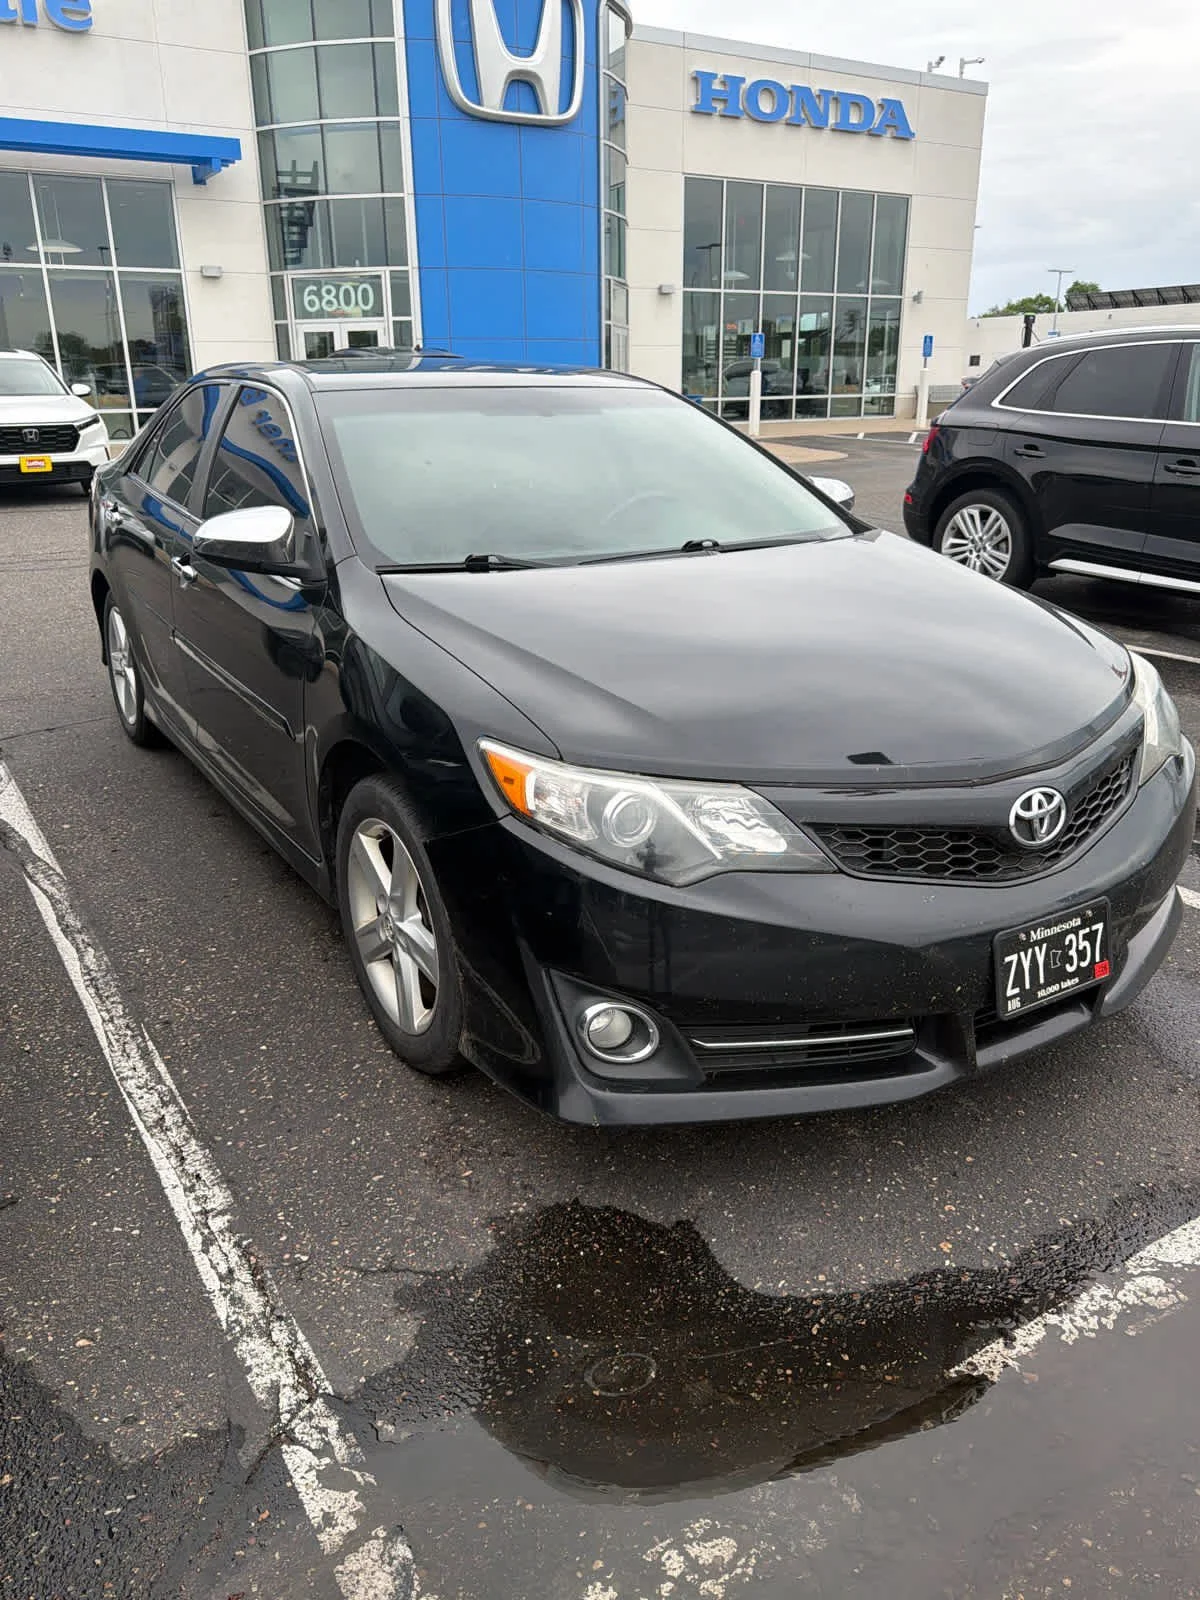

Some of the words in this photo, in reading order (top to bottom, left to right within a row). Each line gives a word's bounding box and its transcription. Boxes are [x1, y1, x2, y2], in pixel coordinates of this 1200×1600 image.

[692, 69, 915, 141] HONDA
[303, 283, 374, 312] 6800
[1029, 917, 1082, 942] Minnesota
[1003, 942, 1047, 997] ZYY
[1064, 922, 1104, 973] 357
[1061, 976, 1080, 989] lakes
[1007, 996, 1021, 1012] AUG
